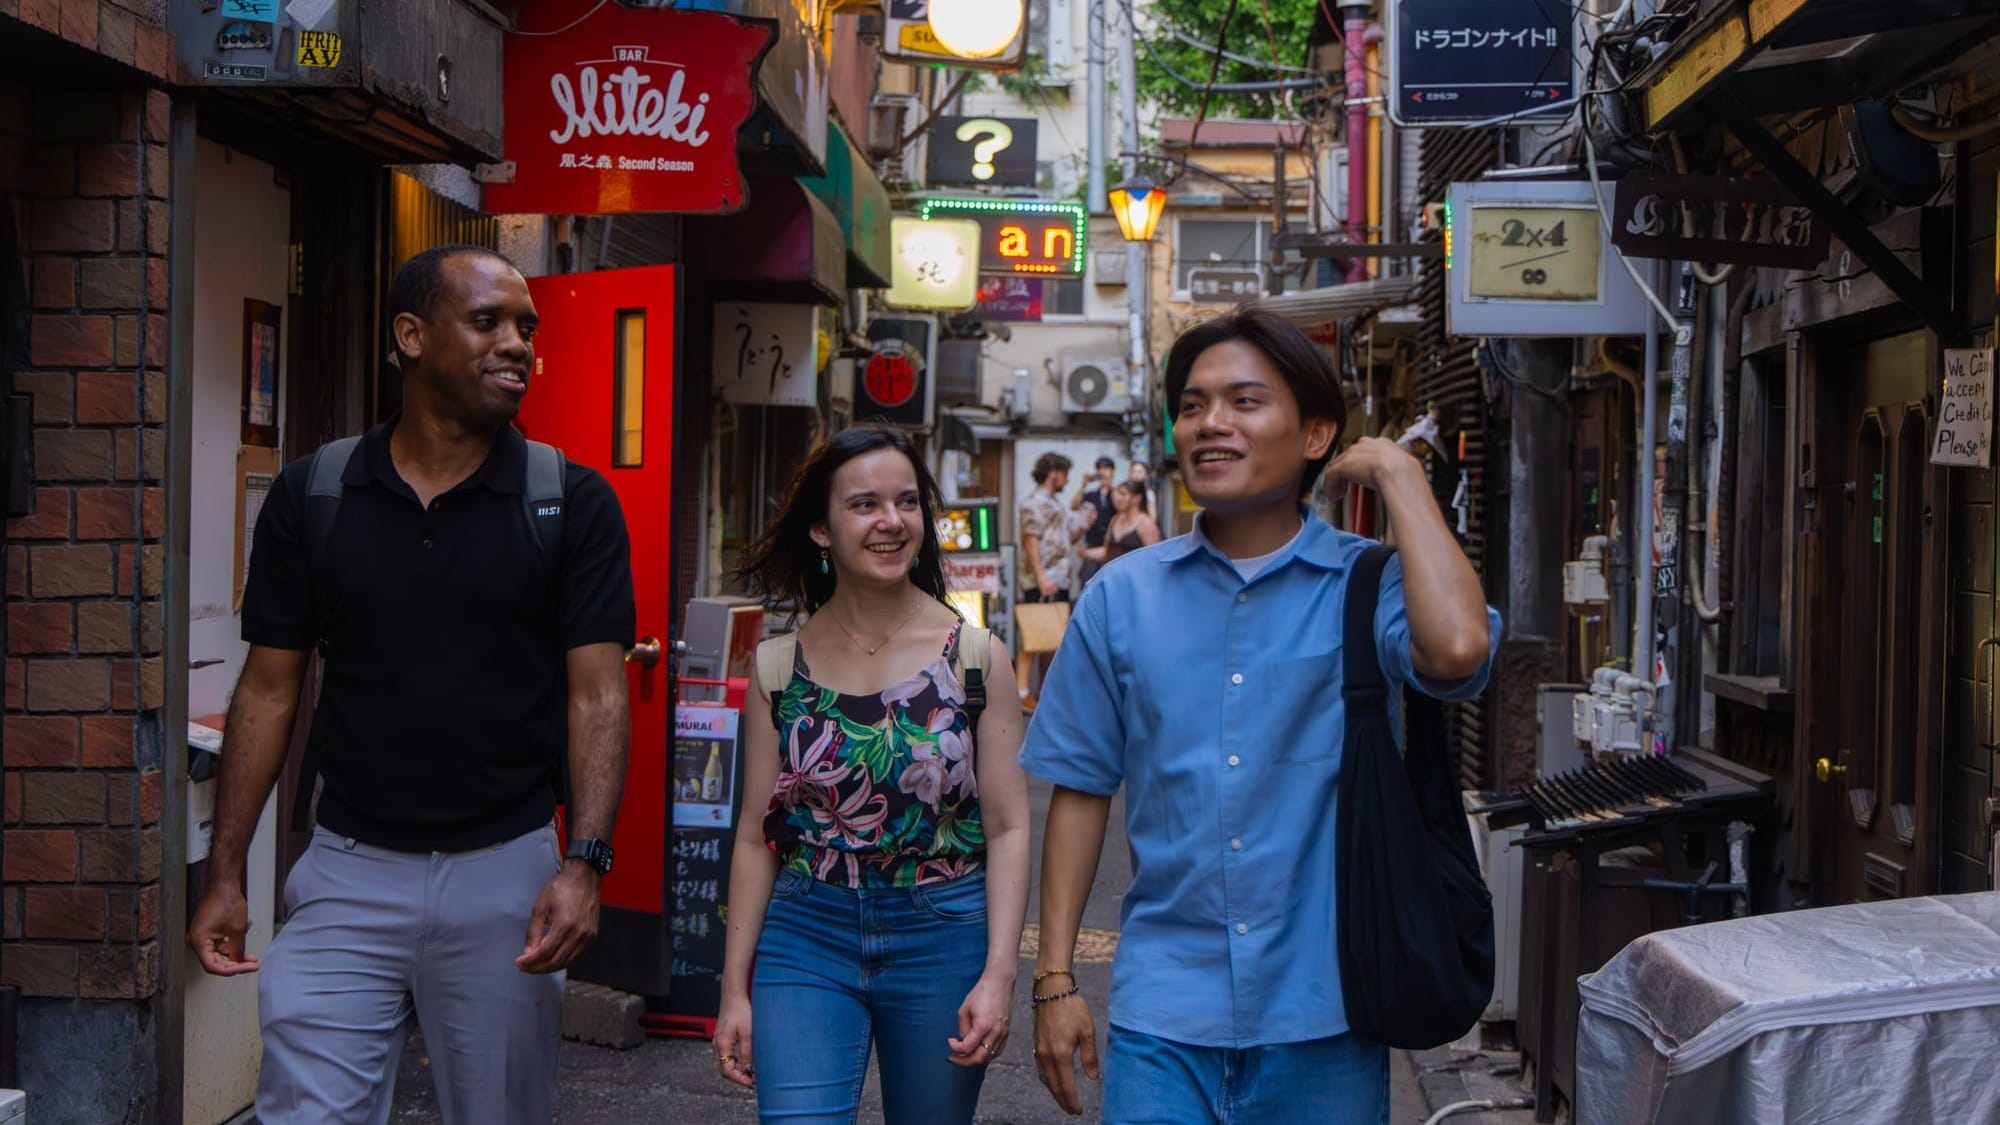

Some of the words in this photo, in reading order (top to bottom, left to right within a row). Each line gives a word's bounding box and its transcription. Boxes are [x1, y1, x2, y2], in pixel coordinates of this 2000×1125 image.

[1415, 28, 1557, 49] ドラゴンナイト!!
[299, 50, 337, 66] AV
[619, 49, 642, 61] BAR
[618, 156, 655, 171] Second
[657, 157, 694, 172] Season
[1948, 358, 1965, 376] We
[1946, 382, 1985, 398] accept
[1944, 402, 1979, 423] Credit
[1937, 429, 1978, 457] Please
[946, 560, 995, 579] harge
[675, 721, 712, 732] MURAI
[673, 838, 720, 862] とり様
